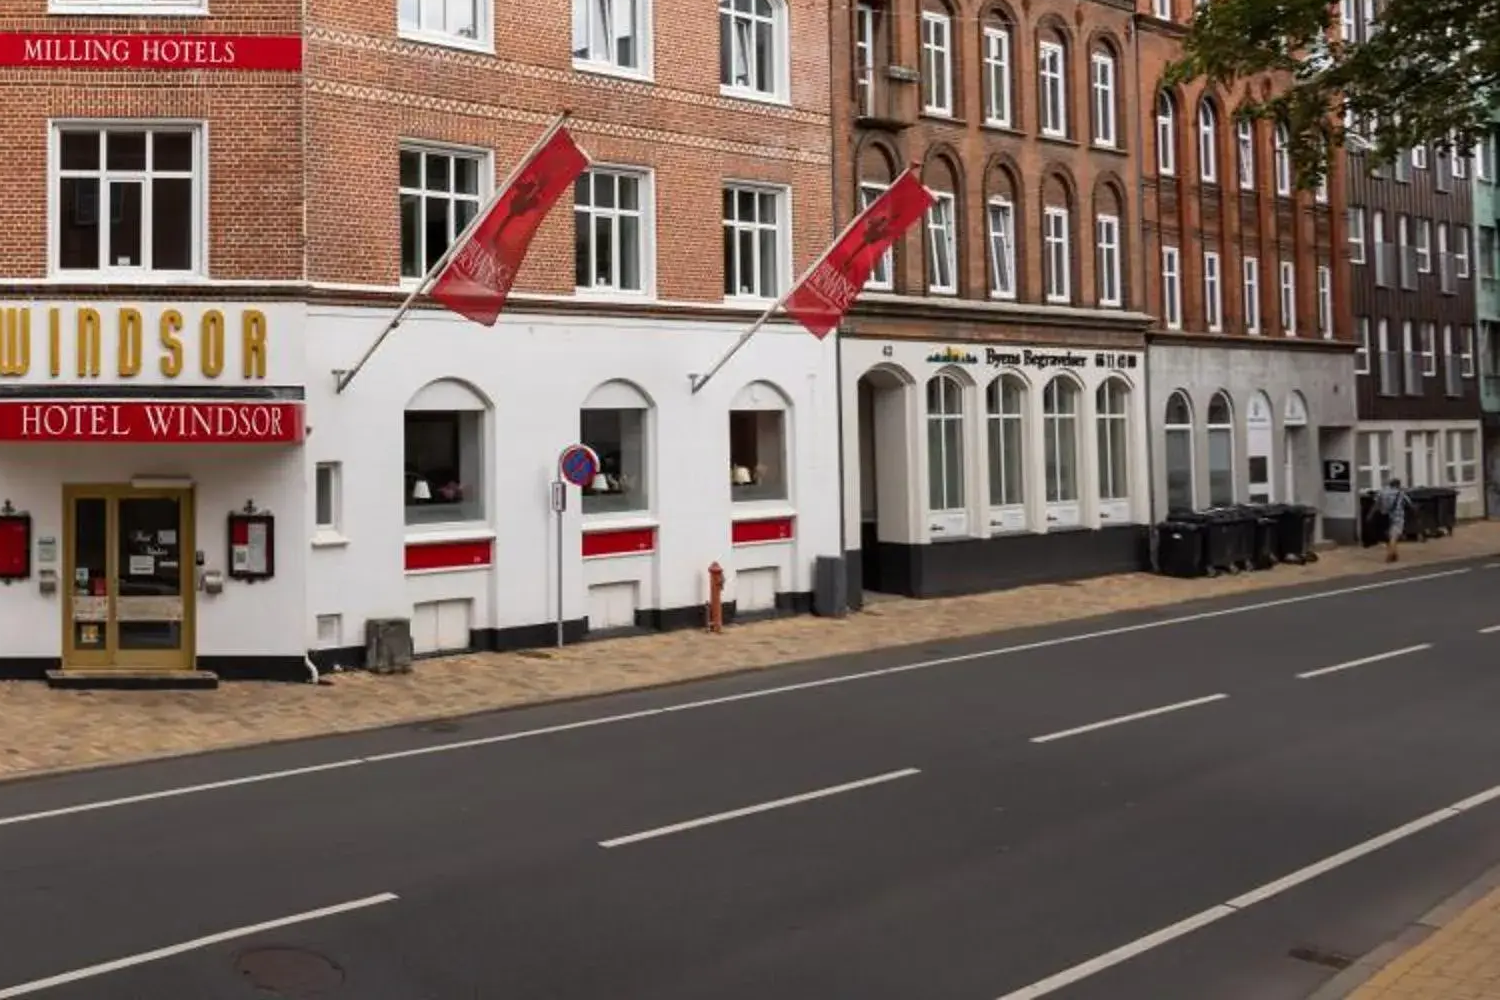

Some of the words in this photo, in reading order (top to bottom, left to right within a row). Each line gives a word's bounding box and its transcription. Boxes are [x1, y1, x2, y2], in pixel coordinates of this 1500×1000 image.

[23, 39, 130, 62] MILLING
[142, 40, 236, 63] HOTELS
[21, 406, 131, 436] HOTEL
[144, 405, 284, 437] WINDSOR
[1330, 462, 1345, 479] P
